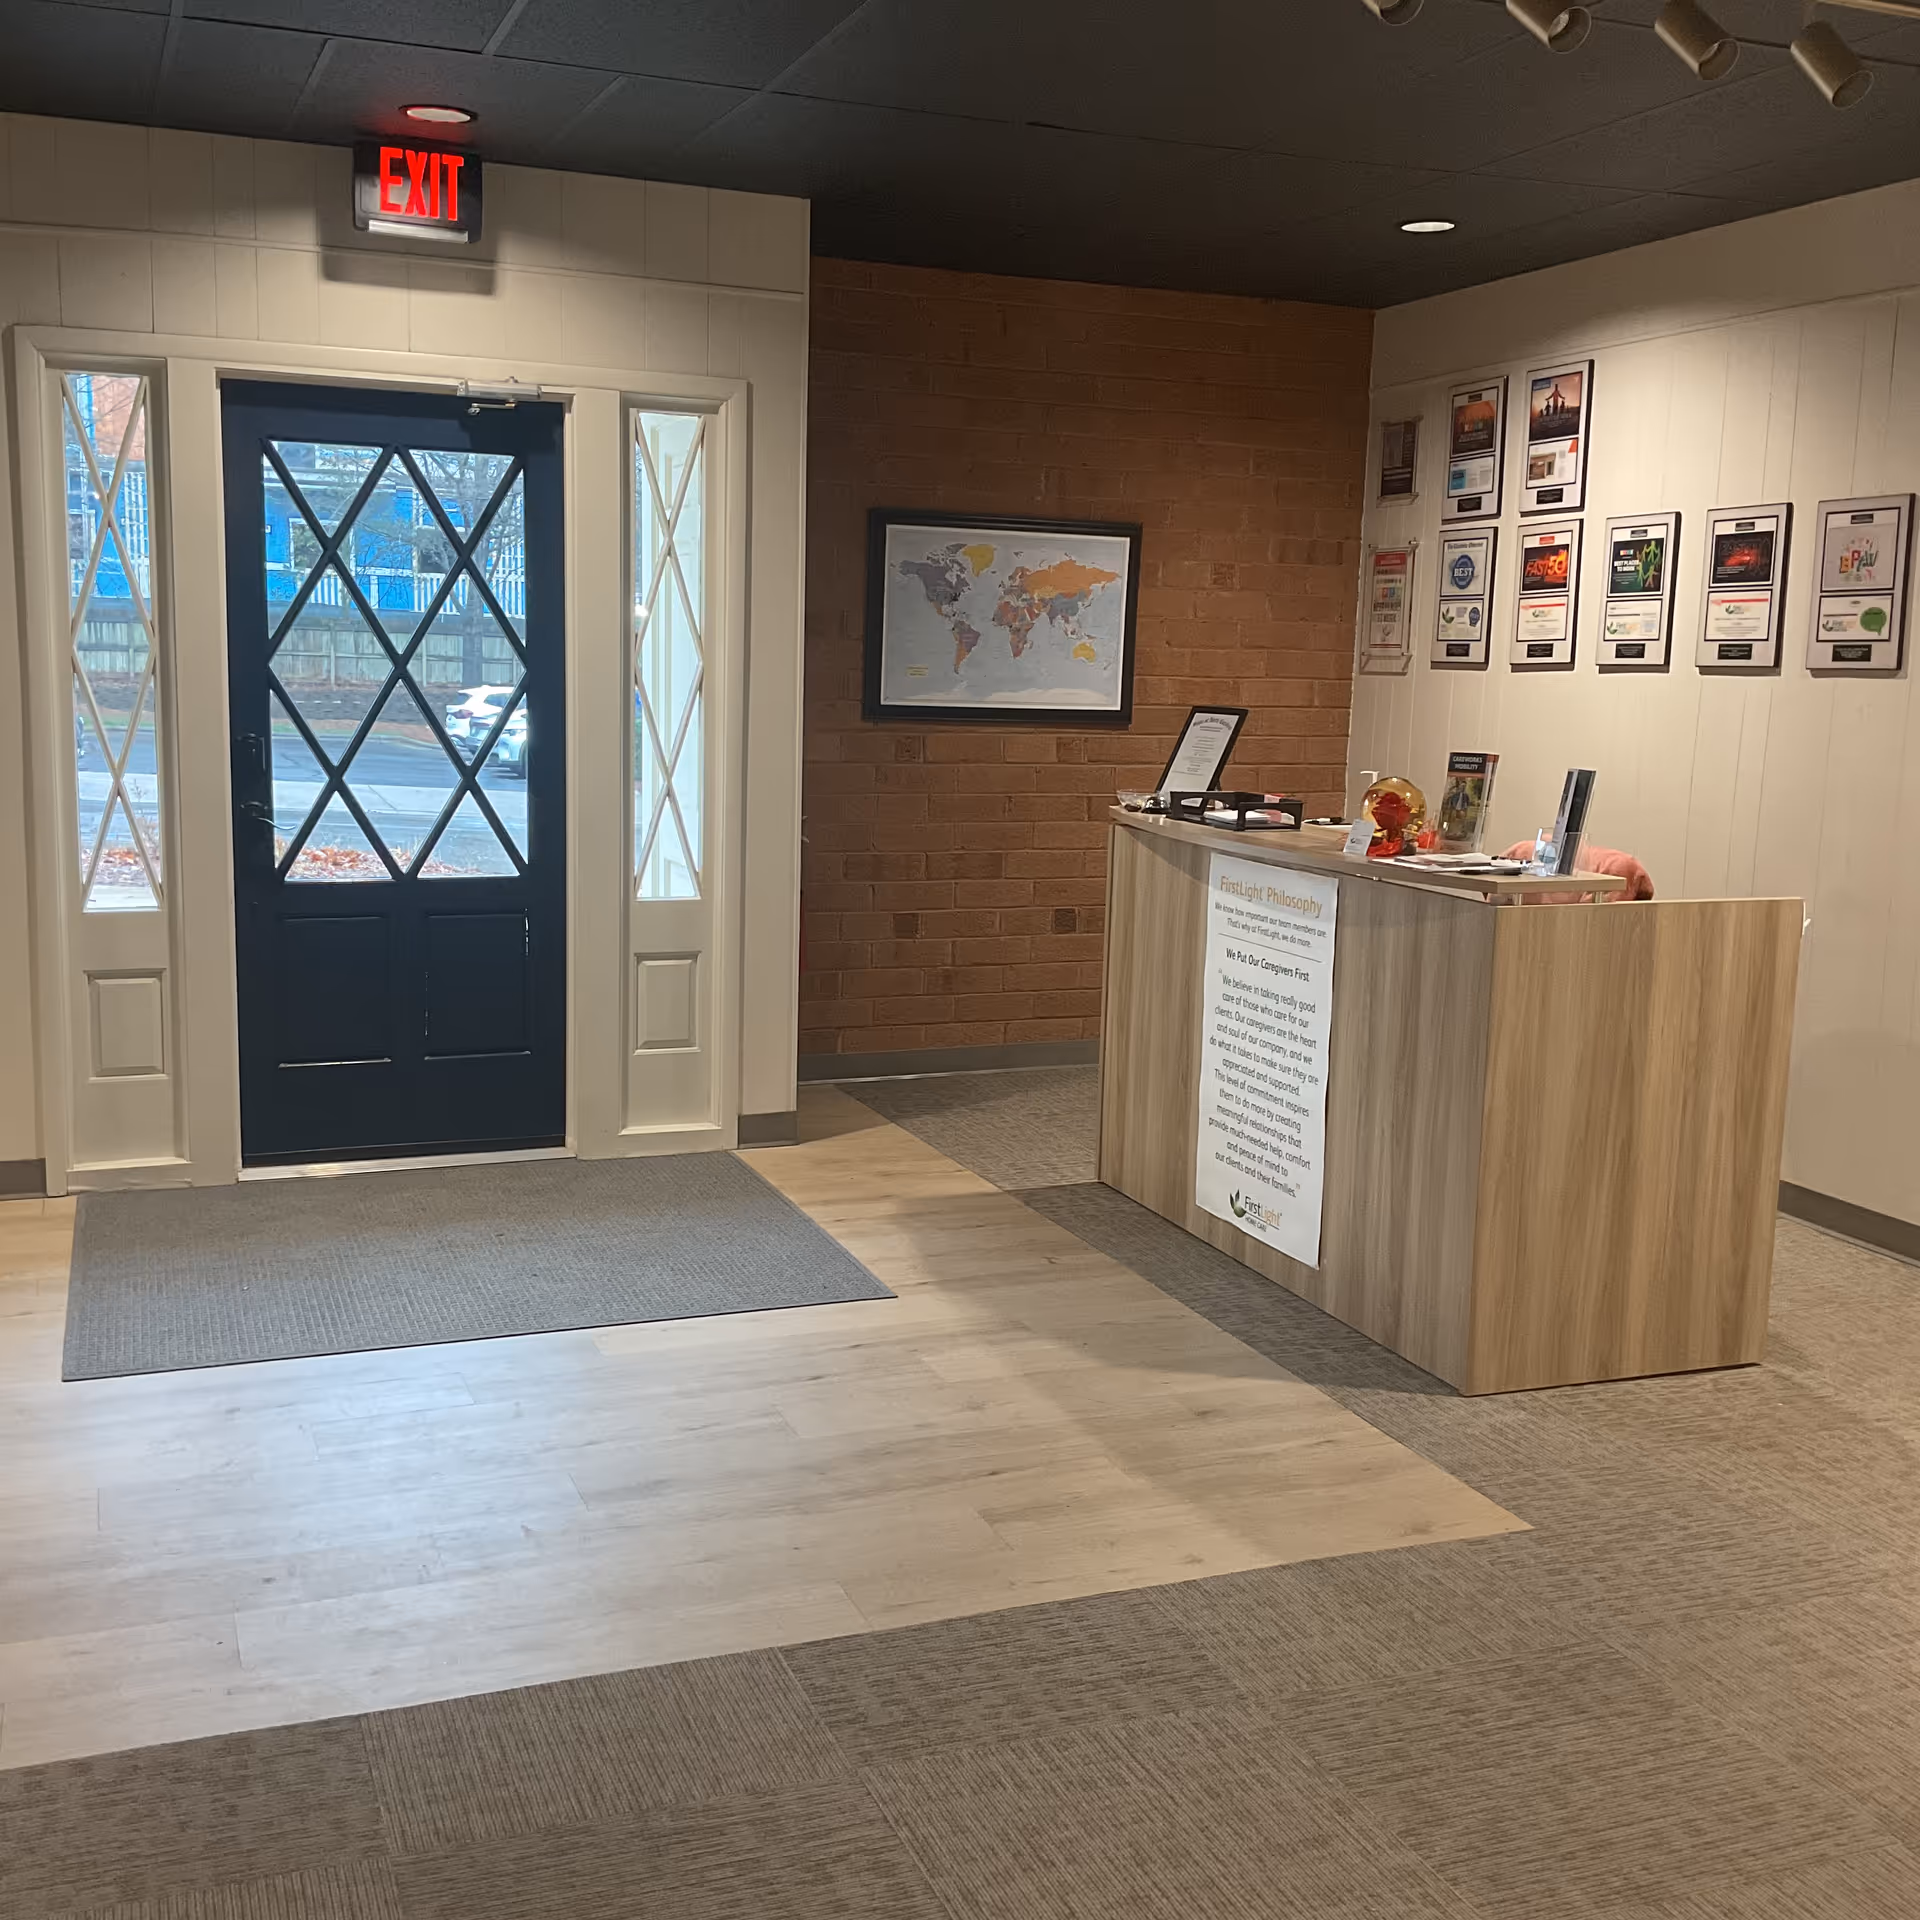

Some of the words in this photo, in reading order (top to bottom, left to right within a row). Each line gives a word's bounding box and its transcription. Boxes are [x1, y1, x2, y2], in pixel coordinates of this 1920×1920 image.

[380, 146, 464, 221] EXIT
[1453, 567, 1473, 577] BEST
[1220, 876, 1264, 902] FirstLight
[1266, 886, 1322, 918] Philosophy
[1223, 903, 1234, 914] know
[1235, 906, 1244, 916] how
[1245, 910, 1268, 922] important
[1269, 917, 1278, 925] our
[1279, 919, 1291, 928] team
[1292, 923, 1316, 936] members
[1242, 921, 1250, 933] why
[1251, 925, 1257, 933] at
[1290, 935, 1296, 944] do
[1226, 948, 1236, 960] We
[1237, 951, 1247, 964] Put
[1249, 954, 1260, 966] Our
[1261, 958, 1293, 978] Caregivers
[1295, 968, 1310, 982] First
[1222, 993, 1235, 1002] care
[1236, 996, 1242, 1006] of
[1243, 998, 1259, 1012] those
[1260, 1004, 1273, 1016] who
[1274, 1009, 1287, 1022] care
[1288, 1012, 1297, 1025] for
[1298, 1018, 1309, 1028] our
[1223, 974, 1232, 986] We
[1233, 978, 1252, 993] believe
[1254, 985, 1259, 995] in
[1261, 988, 1280, 1004] taking
[1281, 995, 1298, 1010] really
[1299, 1001, 1315, 1013] good
[1216, 1023, 1227, 1034] and
[1228, 1027, 1240, 1038] soul
[1241, 1030, 1247, 1041] of
[1248, 1034, 1259, 1044] our
[1259, 1039, 1288, 1058] company,
[1290, 1050, 1302, 1061] and
[1303, 1055, 1312, 1065] we
[1235, 1011, 1245, 1023] Our
[1246, 1017, 1276, 1035] caregivers
[1276, 1027, 1287, 1038] are
[1288, 1030, 1298, 1043] the
[1300, 1034, 1317, 1049] heart
[1210, 1035, 1217, 1046] do
[1218, 1039, 1231, 1052] what
[1232, 1044, 1236, 1054] it
[1238, 1046, 1253, 1060] takes
[1254, 1052, 1260, 1062] to
[1261, 1057, 1278, 1070] make
[1279, 1063, 1292, 1075] sure
[1293, 1067, 1307, 1083] they
[1308, 1074, 1319, 1085] are
[1222, 1058, 1255, 1078] appreciated
[1256, 1072, 1267, 1083] and
[1268, 1076, 1300, 1096] supported.
[1214, 1068, 1225, 1082] This
[1226, 1073, 1239, 1088] level
[1240, 1080, 1246, 1091] of
[1247, 1084, 1284, 1107] commitment
[1285, 1098, 1309, 1117] inspires
[1219, 1088, 1234, 1101] them
[1235, 1094, 1241, 1105] to
[1242, 1098, 1250, 1109] do
[1251, 1103, 1266, 1116] more
[1266, 1108, 1274, 1122] by
[1275, 1113, 1301, 1134] creating
[1209, 1117, 1228, 1132] provide
[1230, 1126, 1268, 1151] much-needed
[1285, 1152, 1311, 1170] comfort
[1217, 1105, 1248, 1125] meaningful
[1249, 1119, 1287, 1143] relationships
[1288, 1134, 1302, 1149] that
[1215, 1152, 1225, 1162] our
[1226, 1156, 1244, 1172] clients
[1244, 1166, 1256, 1177] and
[1257, 1170, 1270, 1184] their
[1227, 1141, 1238, 1152] and
[1239, 1147, 1256, 1162] peace
[1257, 1155, 1264, 1165] of
[1265, 1159, 1280, 1173] mind
[1281, 1166, 1288, 1176] to
[1245, 1196, 1280, 1226] FirstLight
